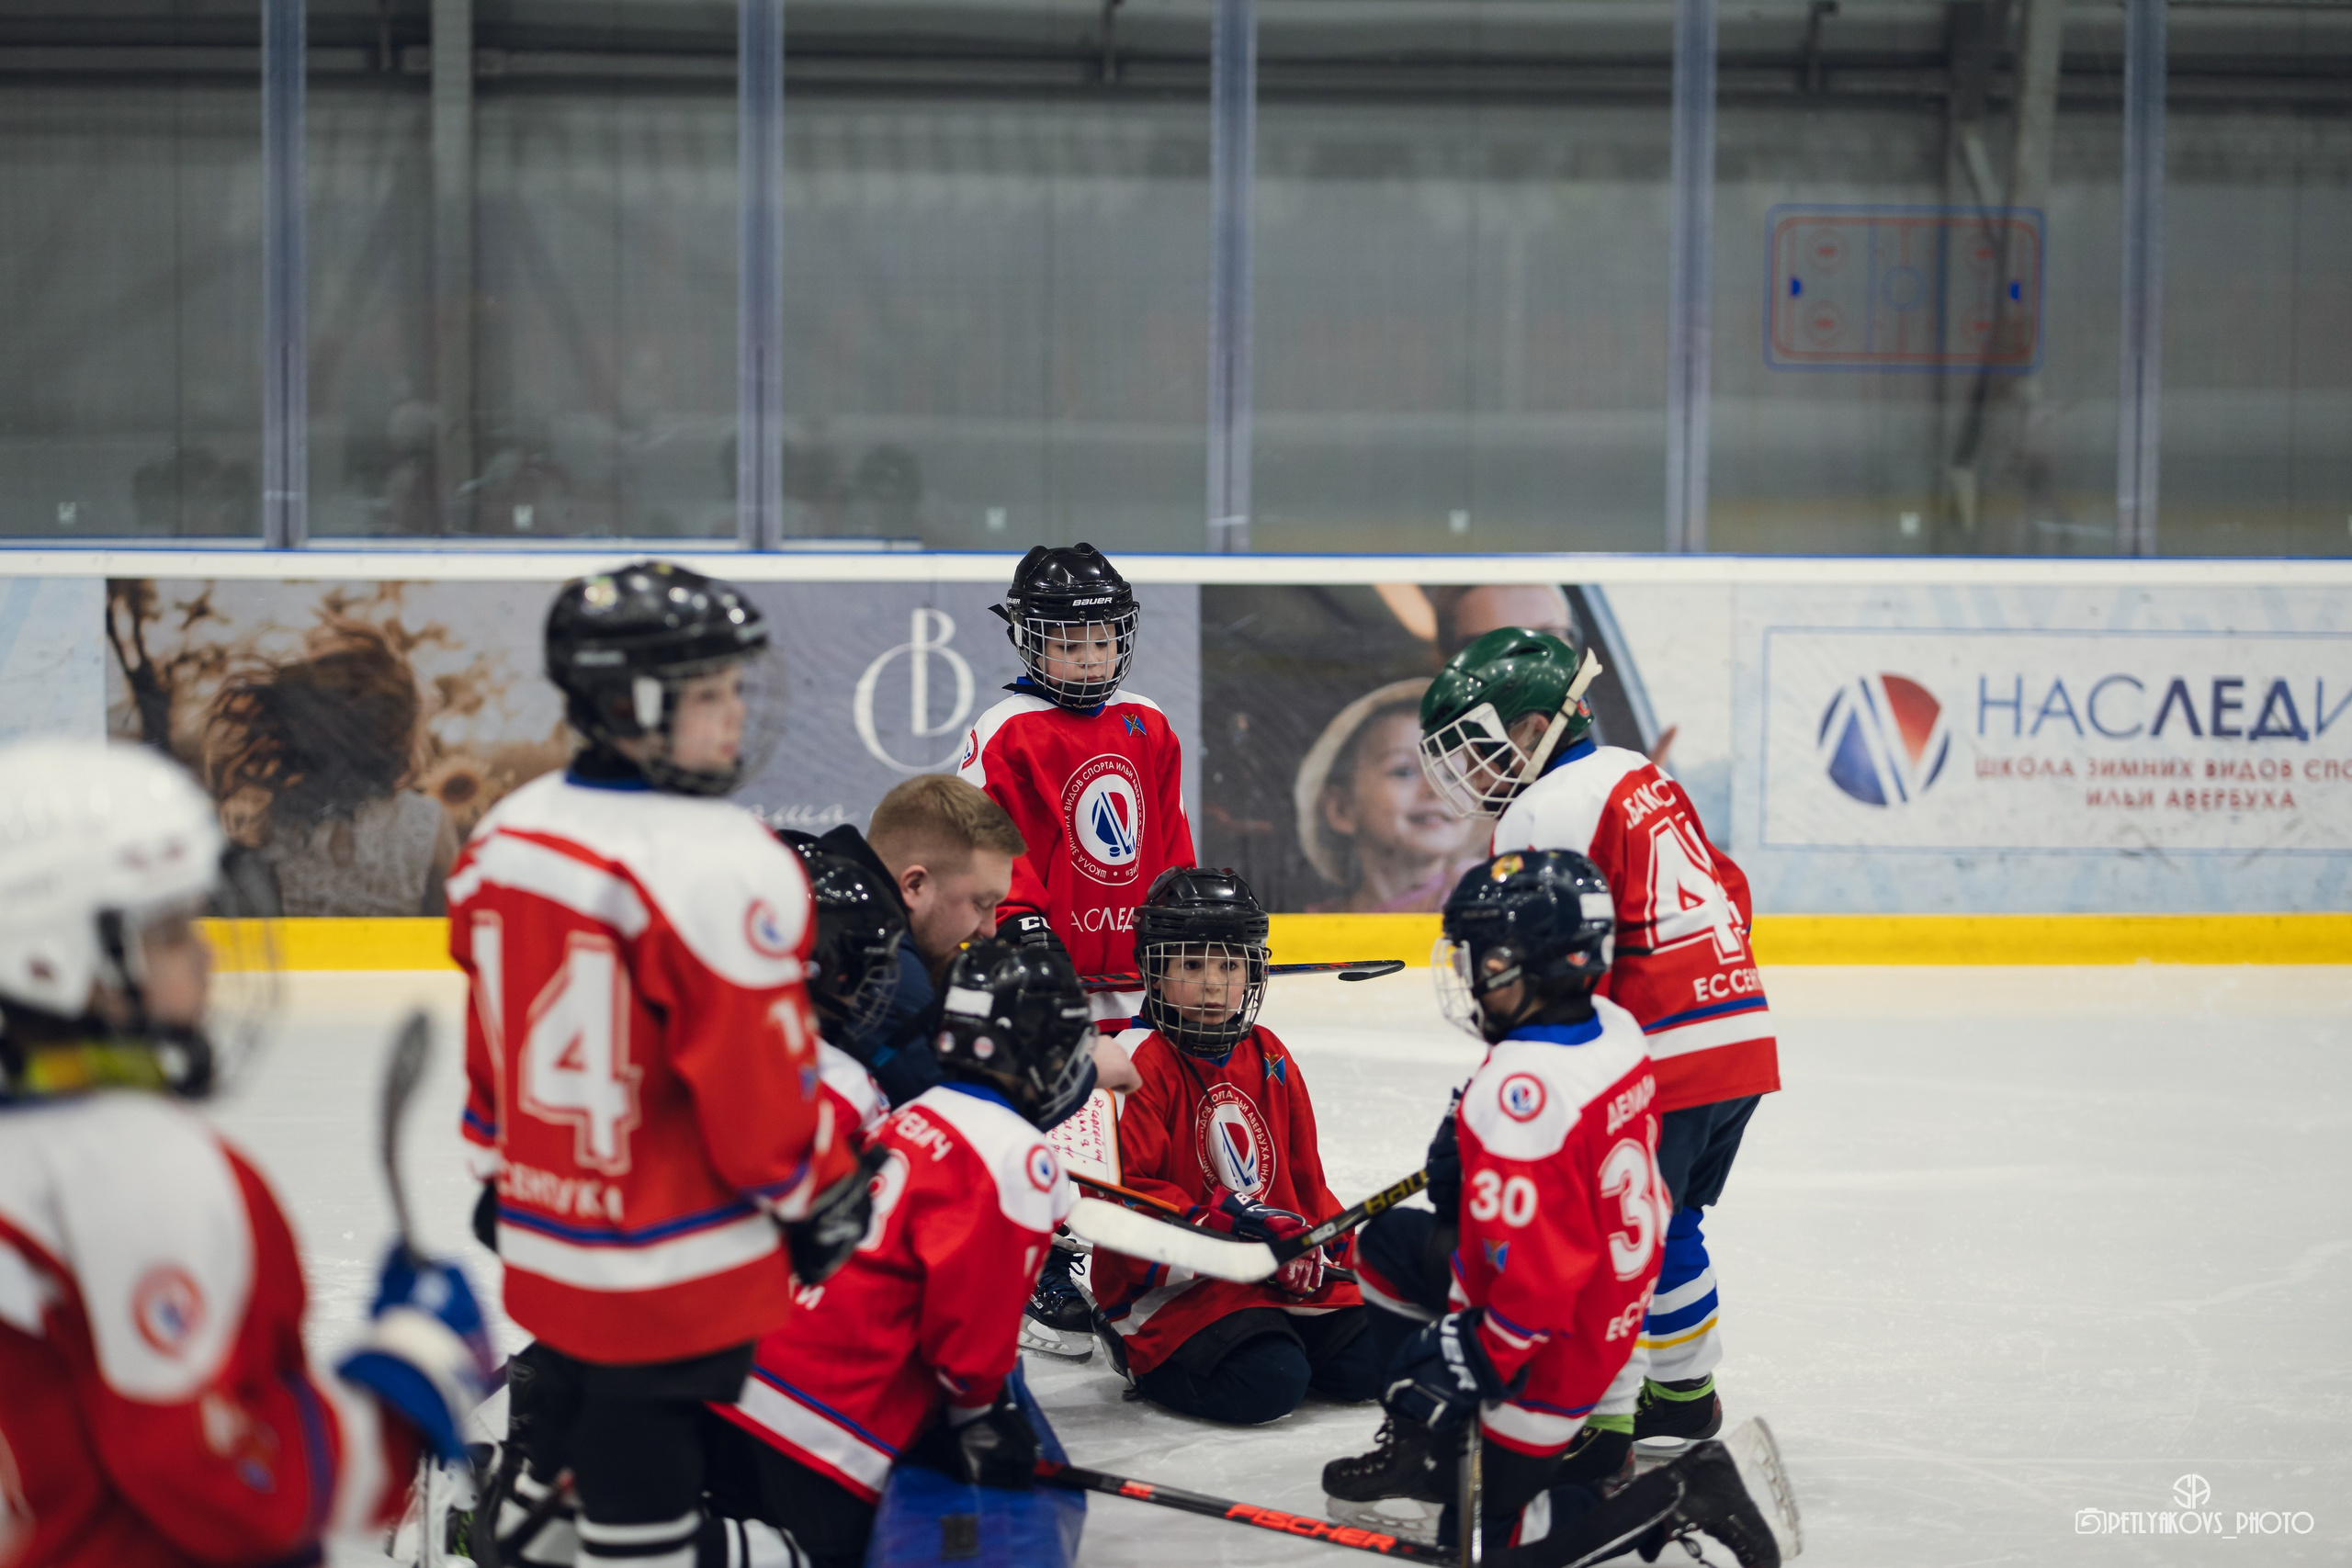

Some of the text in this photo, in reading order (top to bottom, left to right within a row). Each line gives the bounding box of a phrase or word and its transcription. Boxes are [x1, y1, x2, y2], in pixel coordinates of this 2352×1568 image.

[1072, 597, 1113, 606] BAUER
[1082, 761, 1114, 781] СПОРТА
[1115, 761, 1134, 779] ИЛЬИ
[1975, 757, 2075, 780] ШКОЛА
[2086, 757, 2194, 780] ЗИМНИХ
[2205, 758, 2293, 781] ВИДОВ
[1064, 779, 1084, 811] ВИДОВ
[2086, 788, 2298, 810] ИЛЬИ АВЕРБУХА
[1078, 853, 1107, 879] ШКОЛА
[1248, 1111, 1270, 1161] АВЕРБУХА
[1469, 1168, 1537, 1228] 30
[1225, 1502, 1397, 1554] FISCHER
